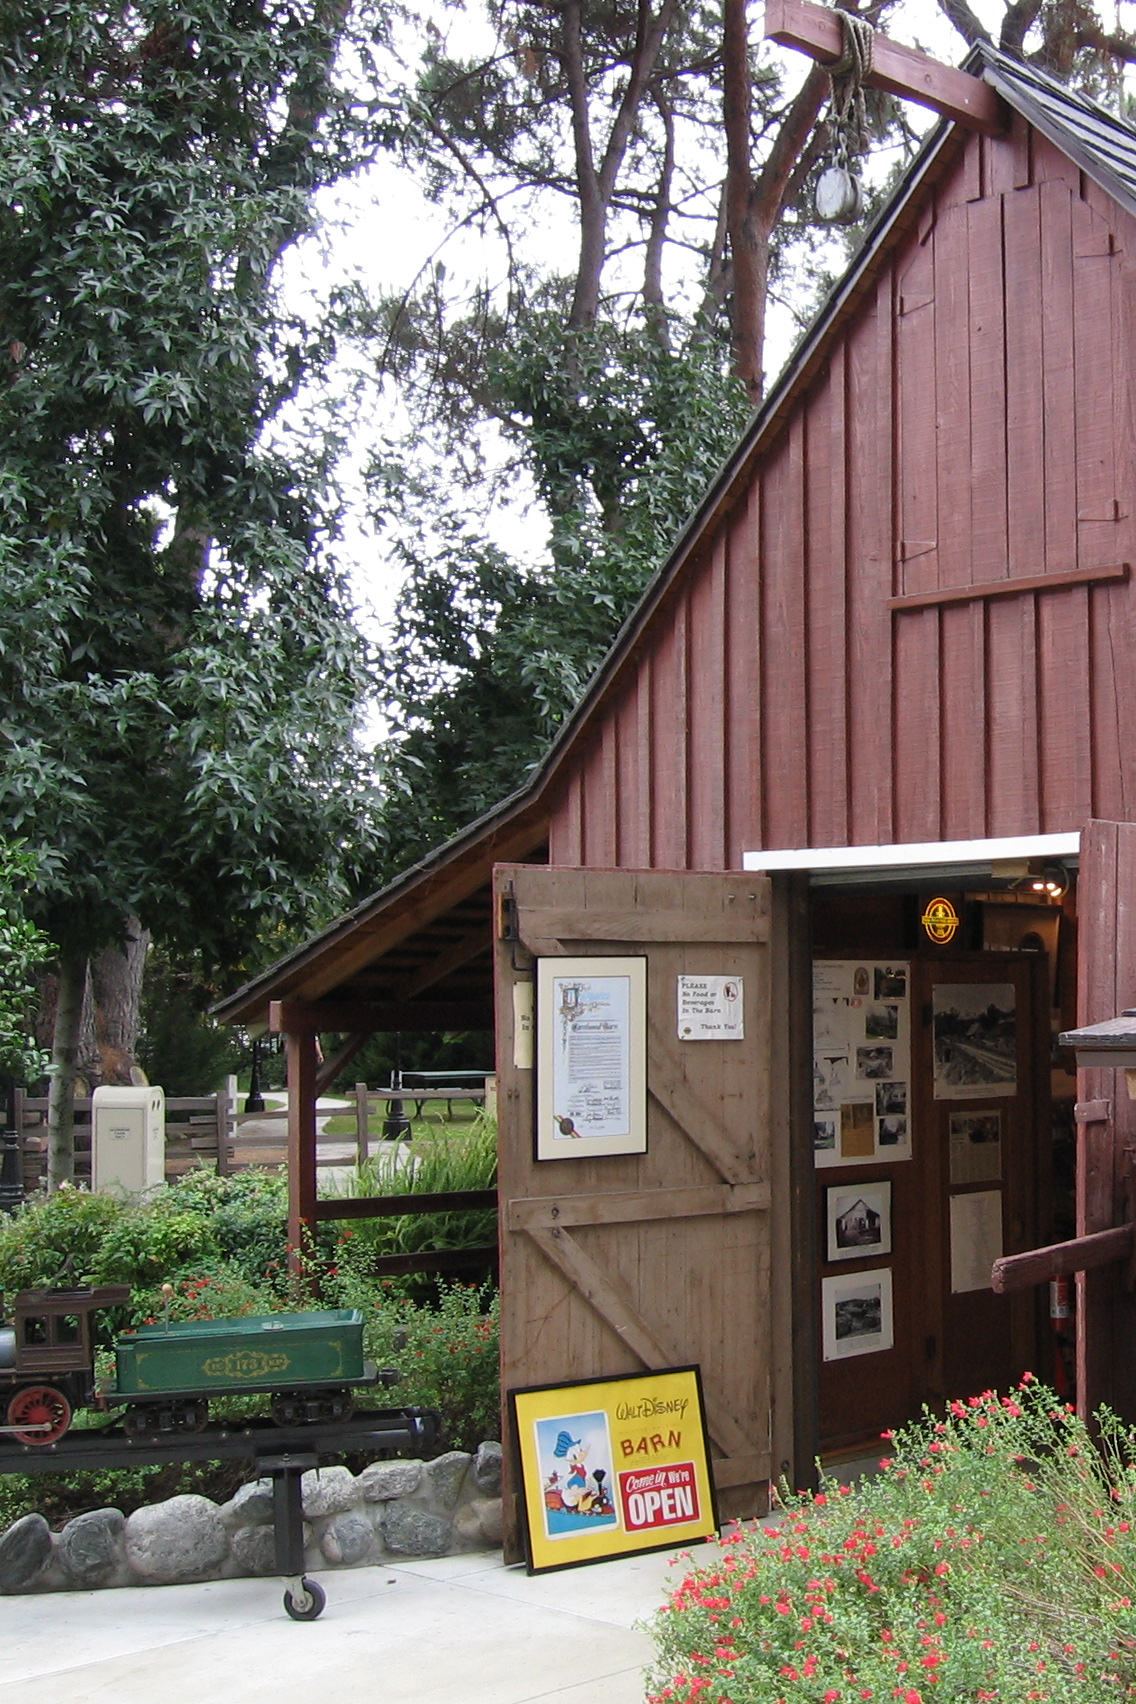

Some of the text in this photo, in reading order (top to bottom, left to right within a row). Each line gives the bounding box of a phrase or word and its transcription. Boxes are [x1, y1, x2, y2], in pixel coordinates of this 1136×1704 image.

[681, 982, 708, 990] PLEASE
[682, 999, 715, 1007] Beverages
[620, 1429, 682, 1458] BARN
[626, 1474, 655, 1493] Come
[628, 1485, 695, 1526] OPEN
